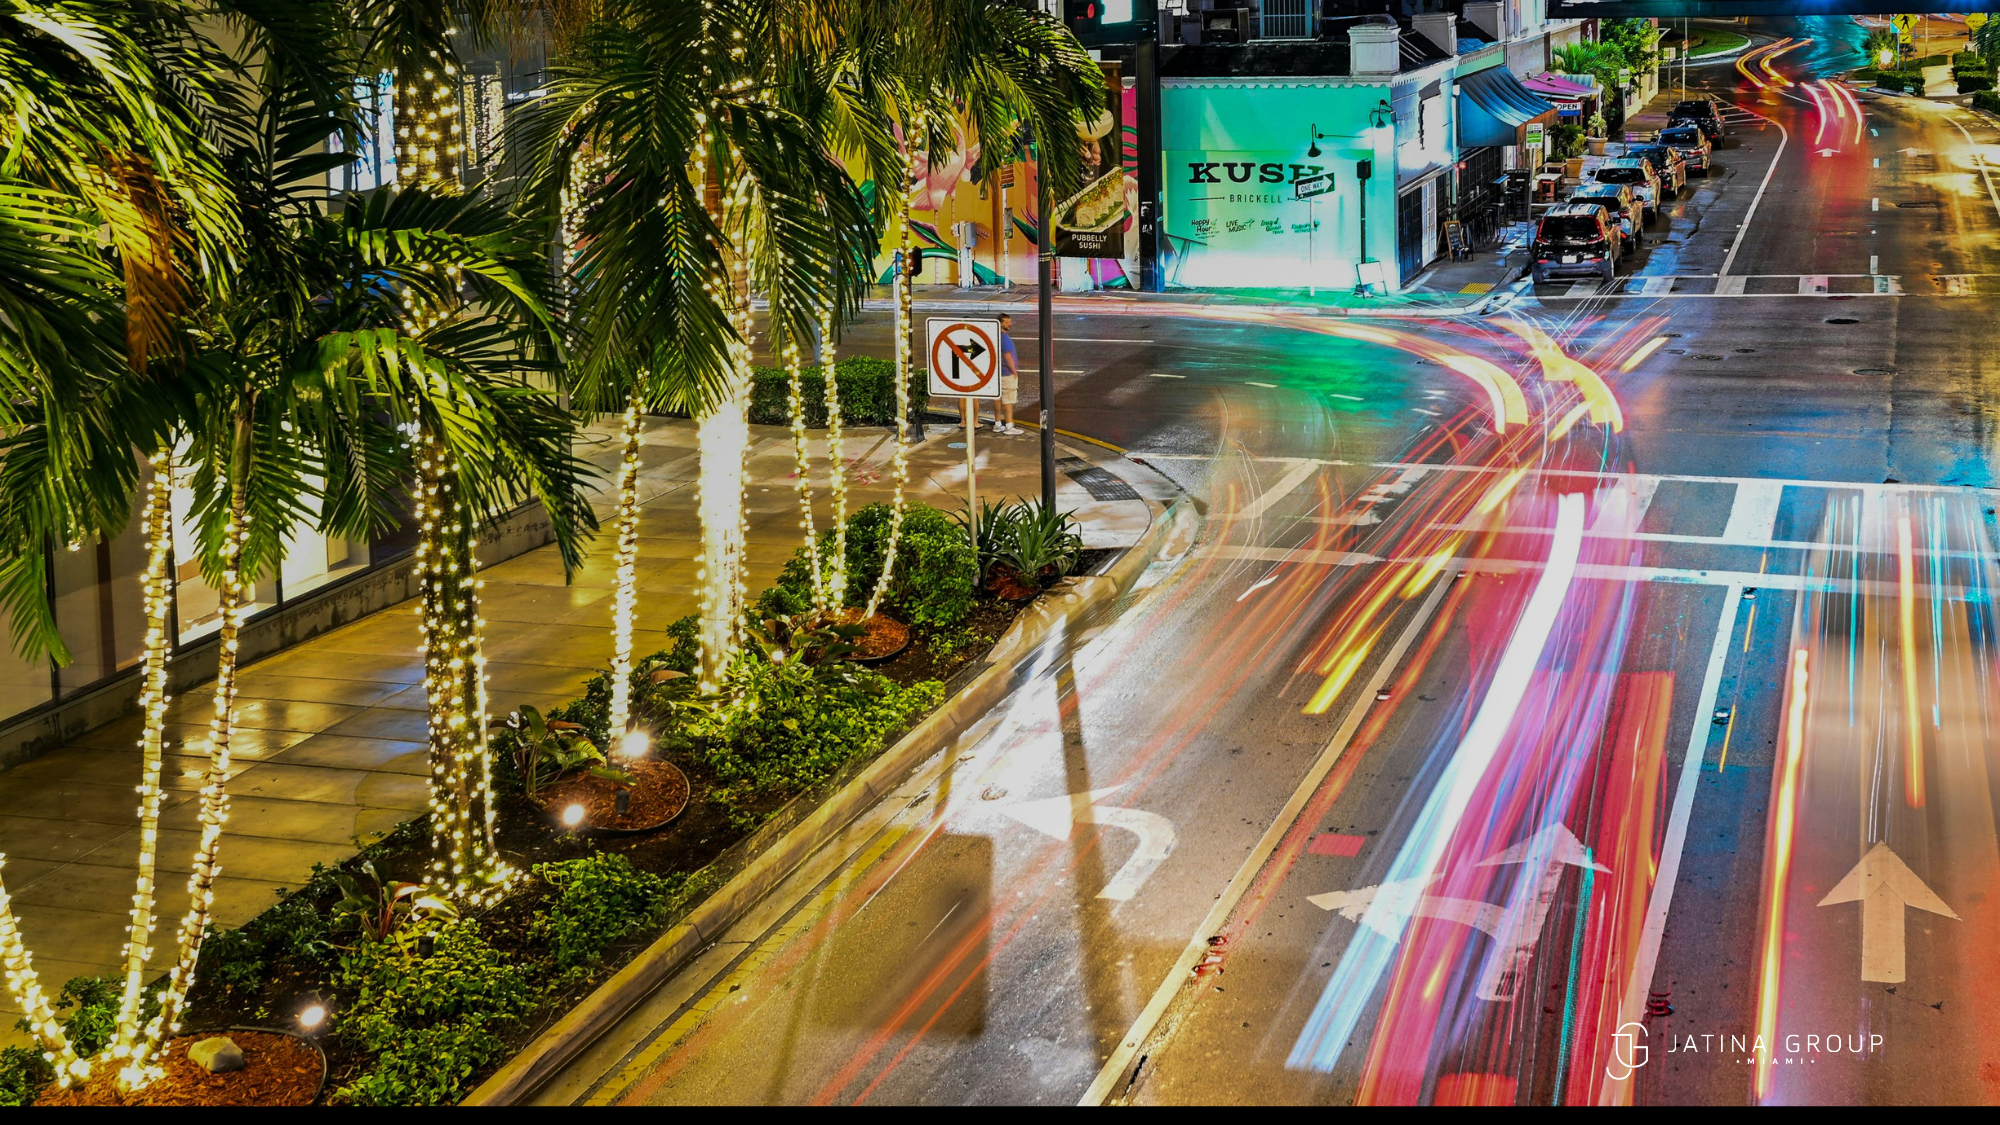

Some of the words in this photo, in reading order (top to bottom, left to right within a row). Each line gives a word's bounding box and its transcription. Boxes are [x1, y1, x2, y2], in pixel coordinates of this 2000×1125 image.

[1188, 162, 1324, 184] KUSH
[1300, 184, 1311, 193] ONE
[1313, 181, 1323, 189] WAY
[1229, 194, 1283, 203] BRICKELL
[1226, 219, 1239, 228] LIVE
[1196, 225, 1213, 233] Hour
[1228, 224, 1247, 233] MUSIC
[1071, 234, 1107, 242] PUBBELLY
[1079, 241, 1101, 249] SUSHI
